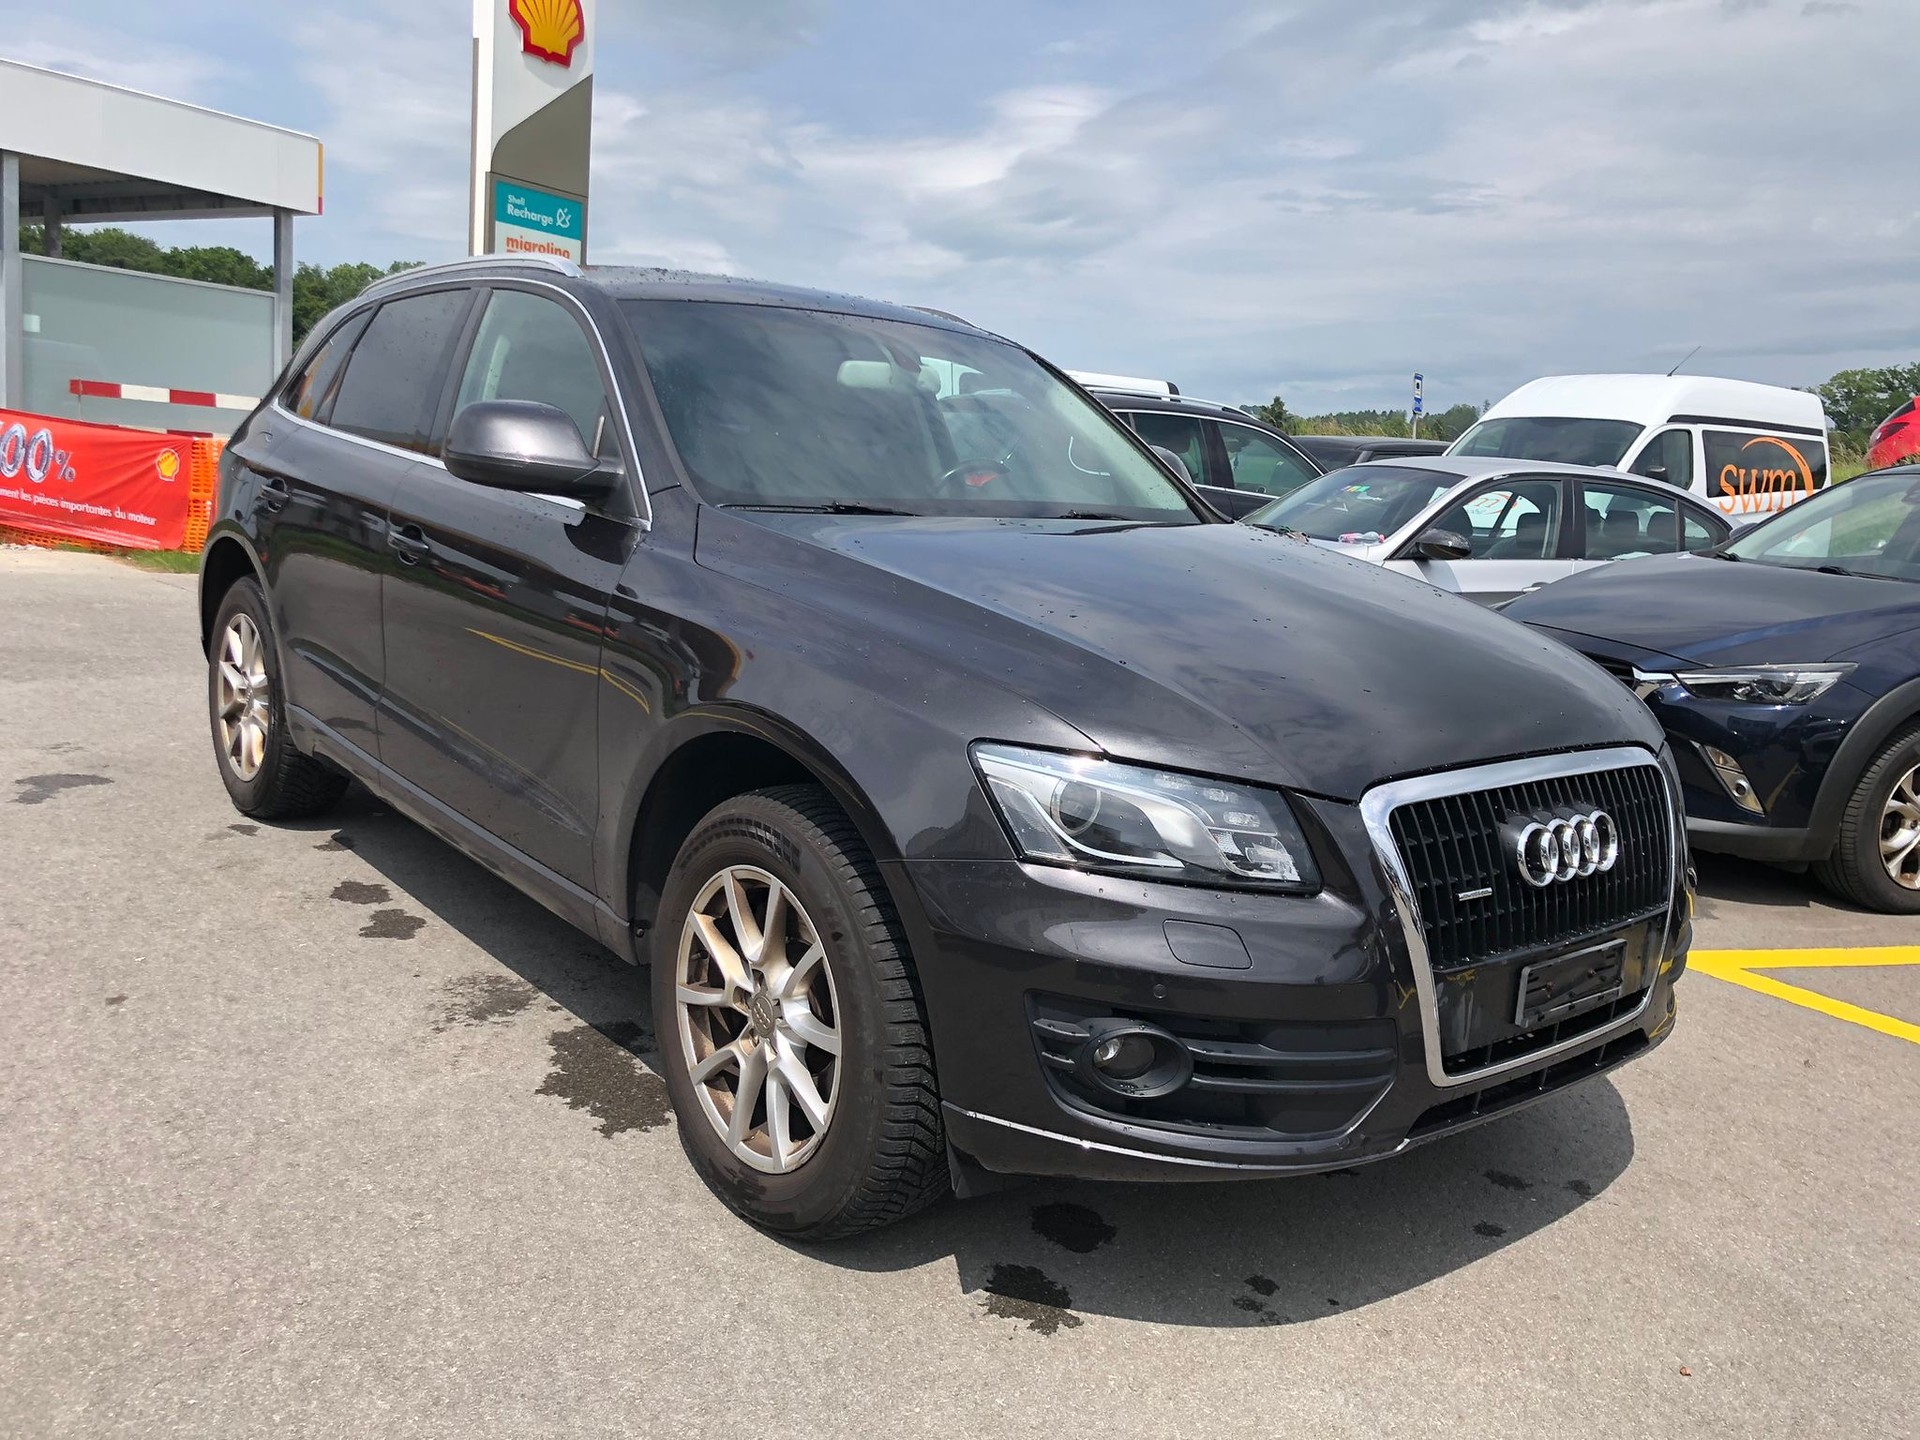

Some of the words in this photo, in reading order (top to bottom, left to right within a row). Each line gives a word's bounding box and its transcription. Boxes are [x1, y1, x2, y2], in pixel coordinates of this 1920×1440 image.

[508, 194, 526, 206] Shell
[507, 203, 554, 227] Recharge
[506, 235, 571, 259] migrolino
[0, 422, 76, 483] 00%
[20, 488, 31, 502] les
[33, 493, 59, 507] pièces
[60, 497, 112, 517] importantes
[114, 506, 126, 520] du
[128, 512, 157, 526] moteur
